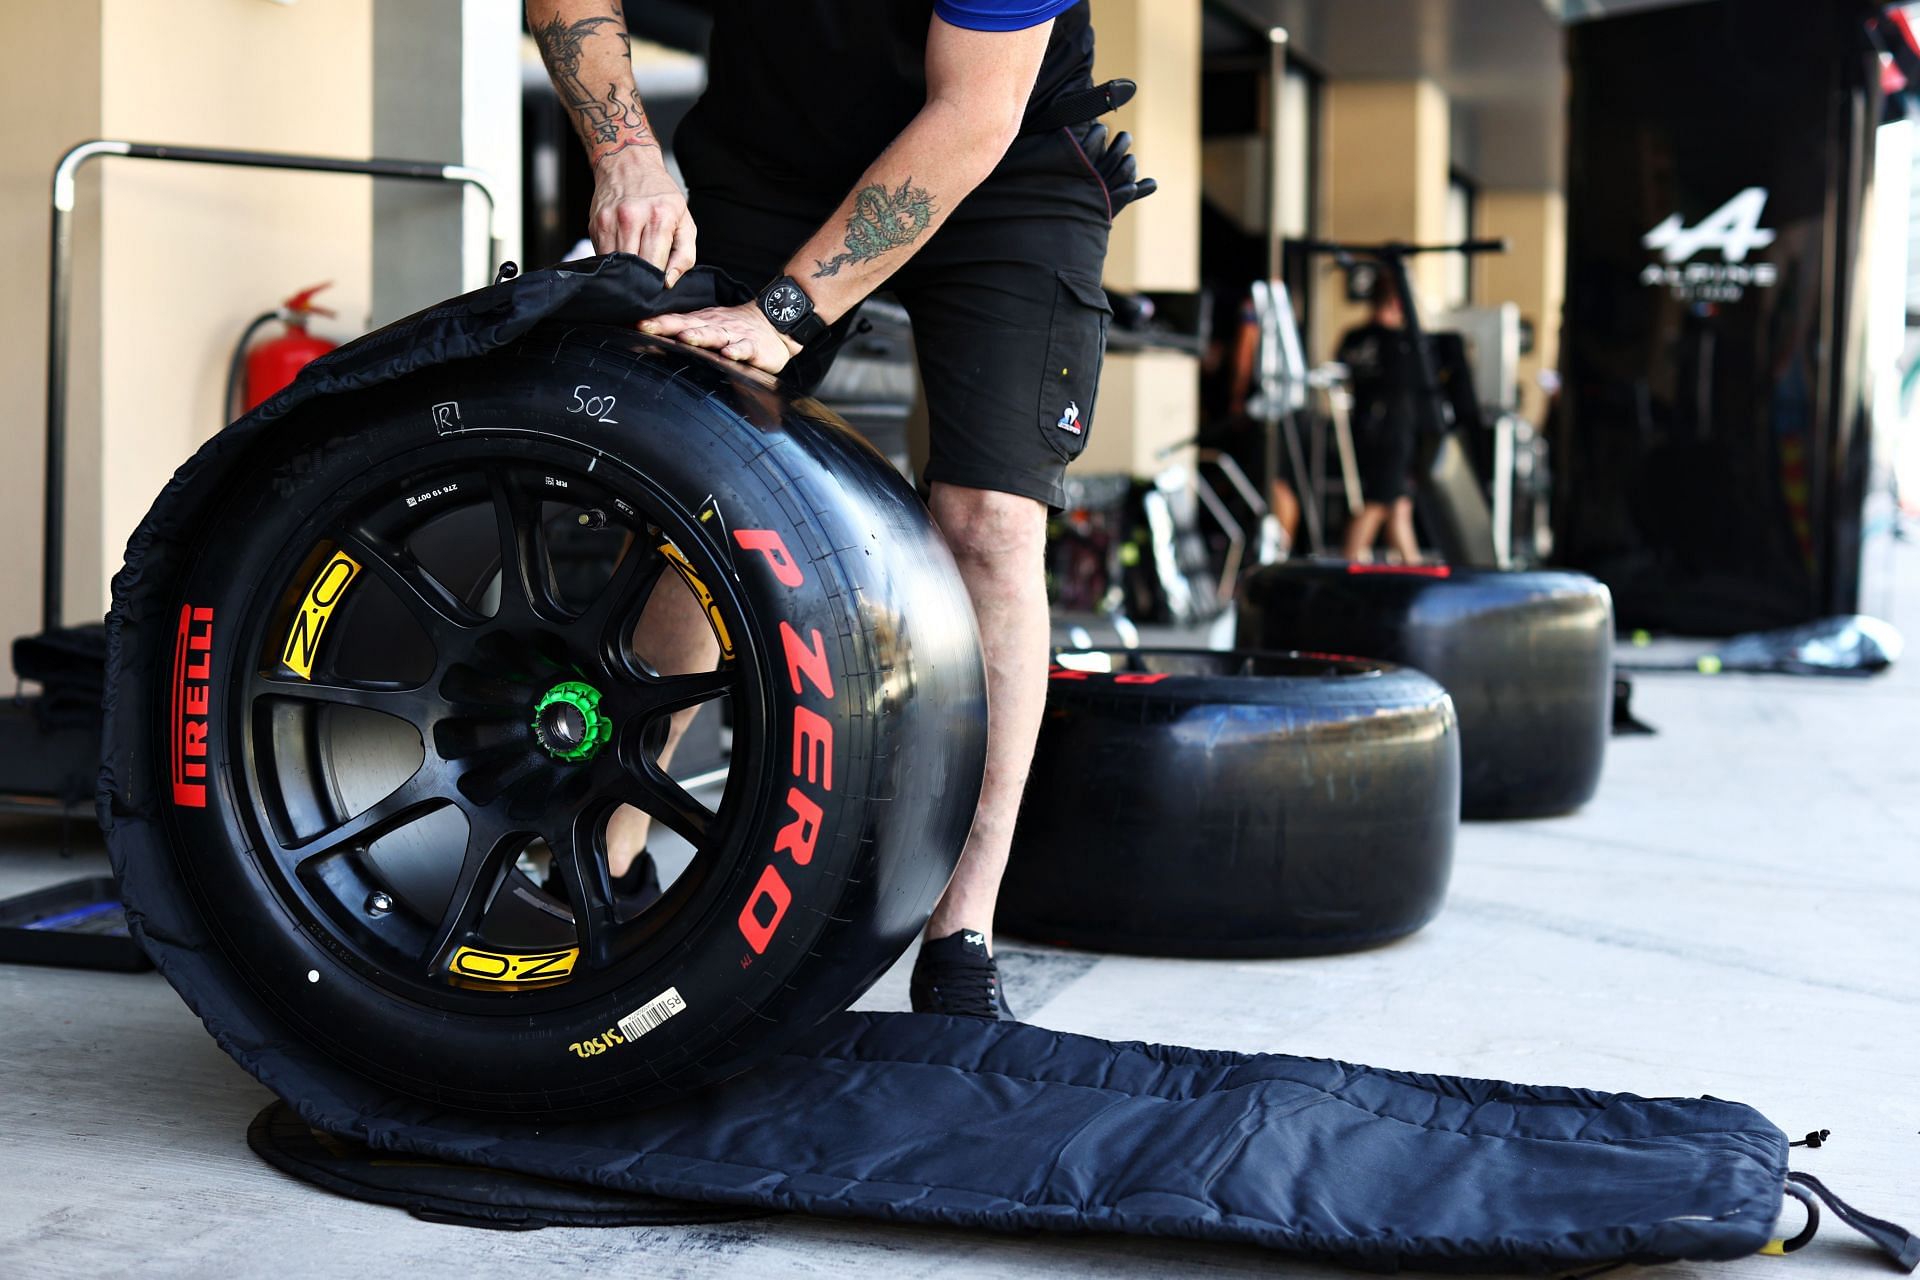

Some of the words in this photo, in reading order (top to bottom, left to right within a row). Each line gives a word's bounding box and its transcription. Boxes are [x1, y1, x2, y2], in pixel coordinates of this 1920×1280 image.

[567, 385, 618, 424] 502
[733, 529, 803, 588] P
[171, 604, 214, 808] PIRELLI
[738, 621, 834, 955] ZERO
[569, 1028, 625, 1058] 31502
